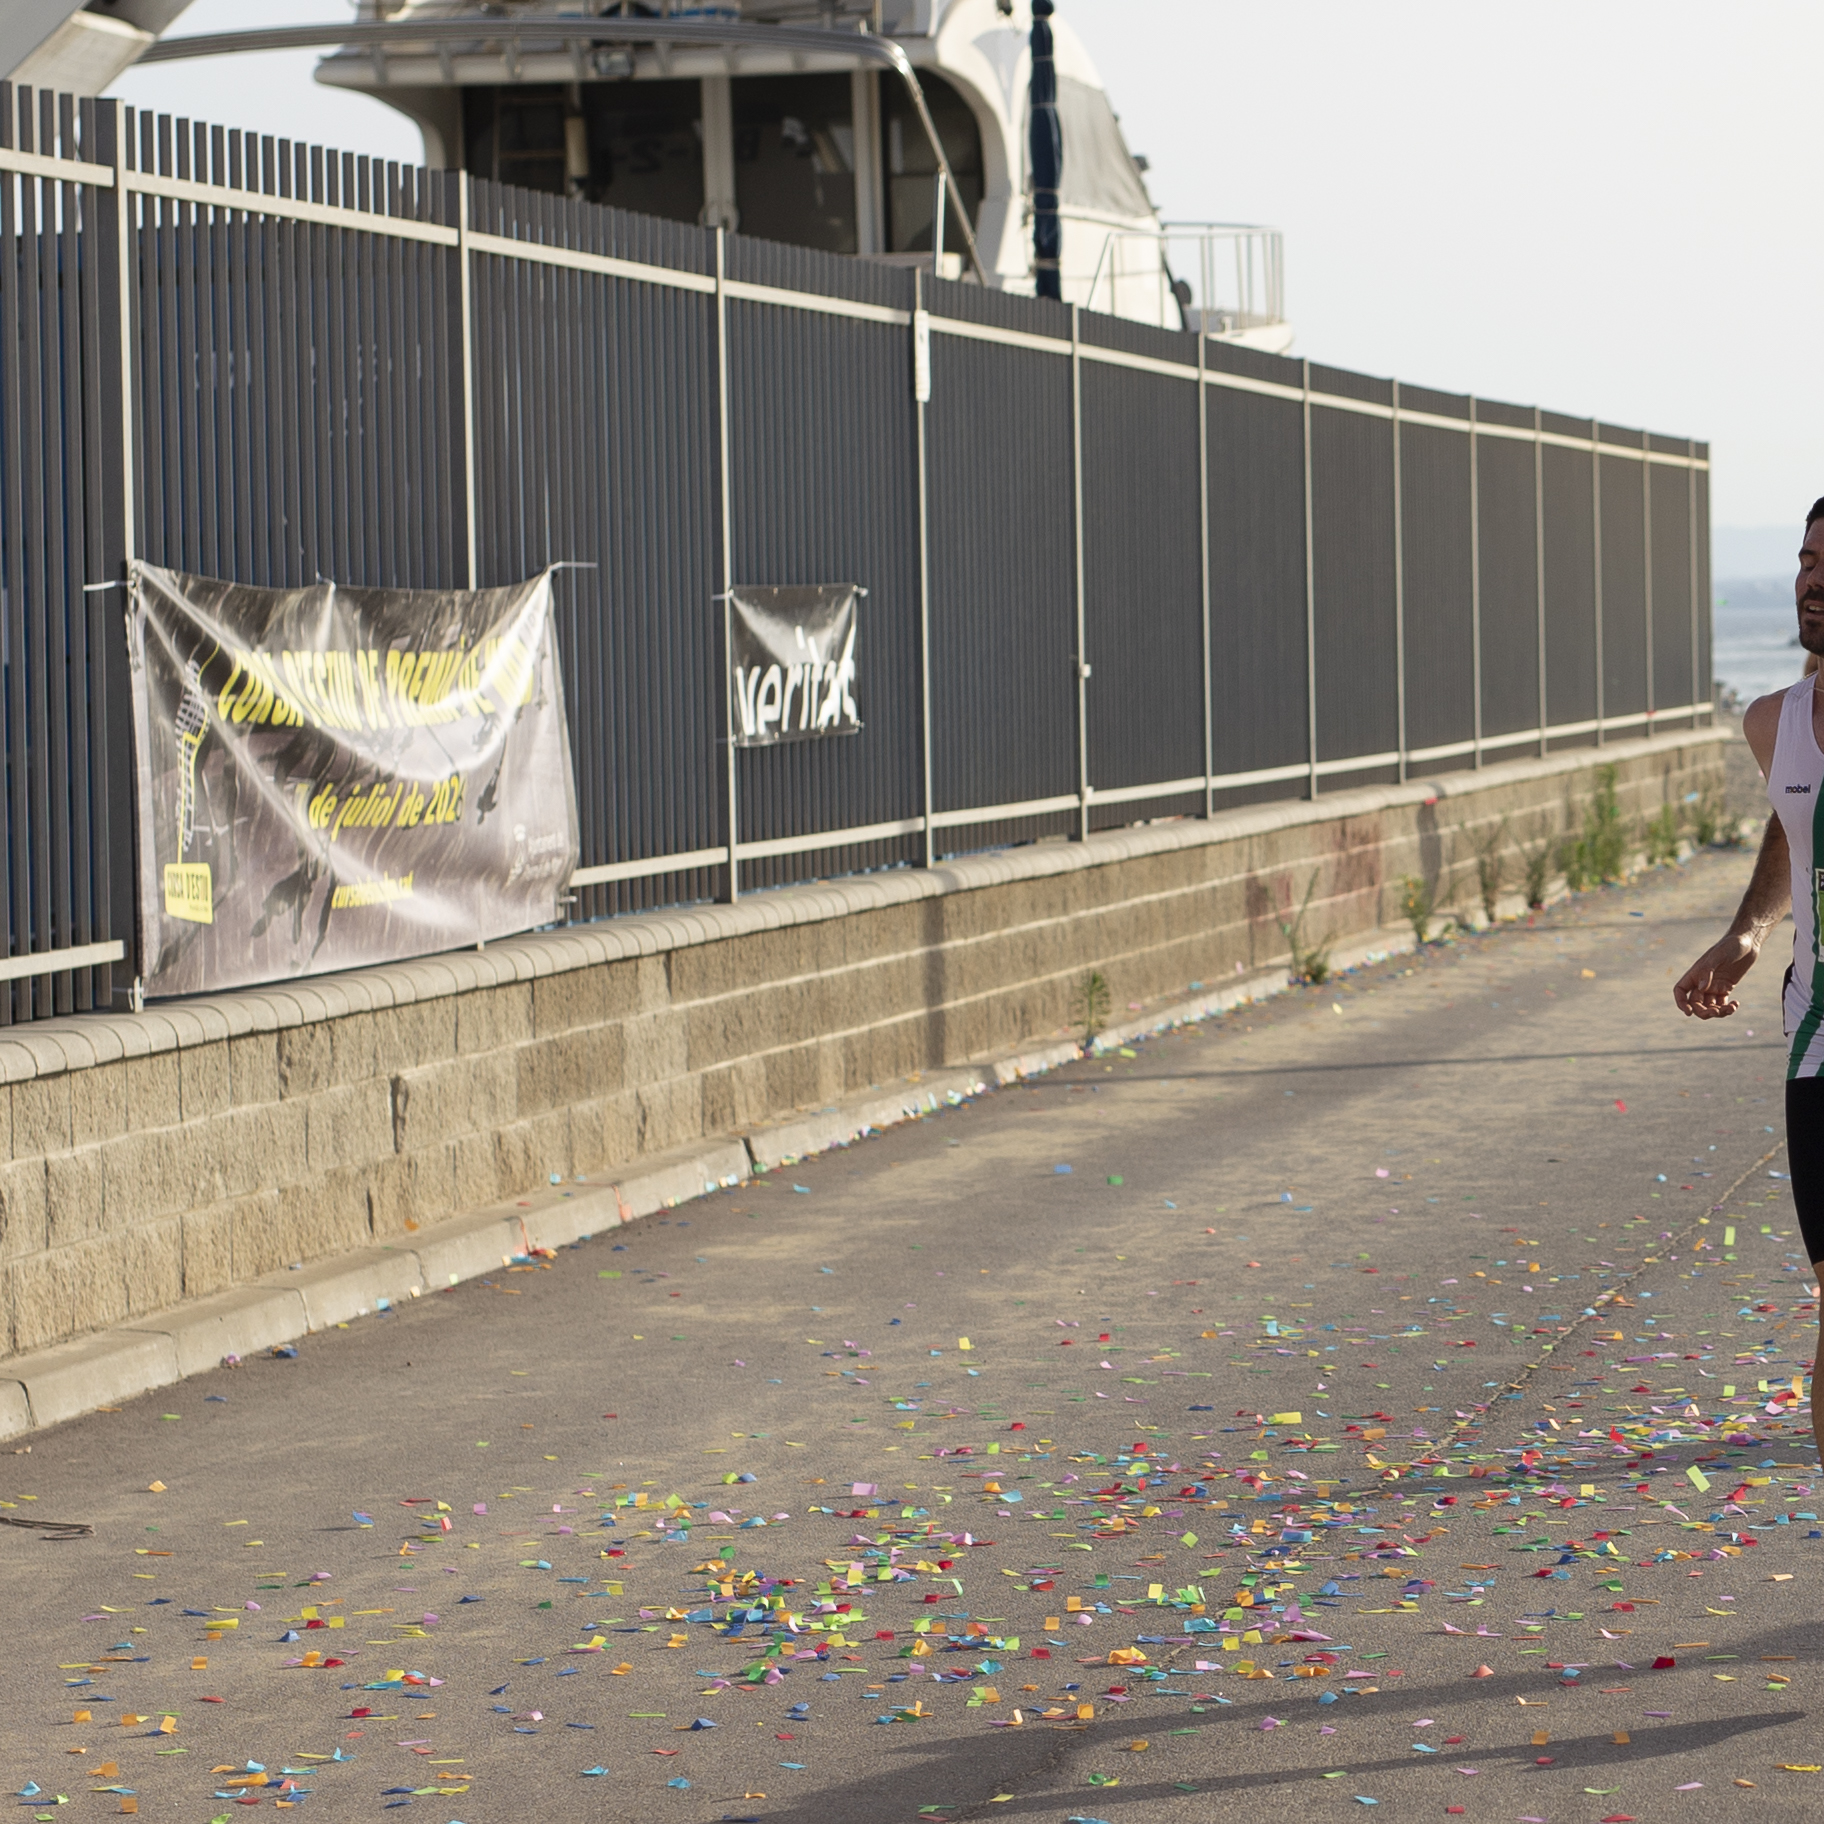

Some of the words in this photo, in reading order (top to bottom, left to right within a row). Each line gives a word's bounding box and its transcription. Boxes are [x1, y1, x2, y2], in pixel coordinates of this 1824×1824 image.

[356, 649, 391, 732] DE
[308, 782, 338, 829] de
[330, 781, 404, 843] juliol
[396, 780, 425, 827] de
